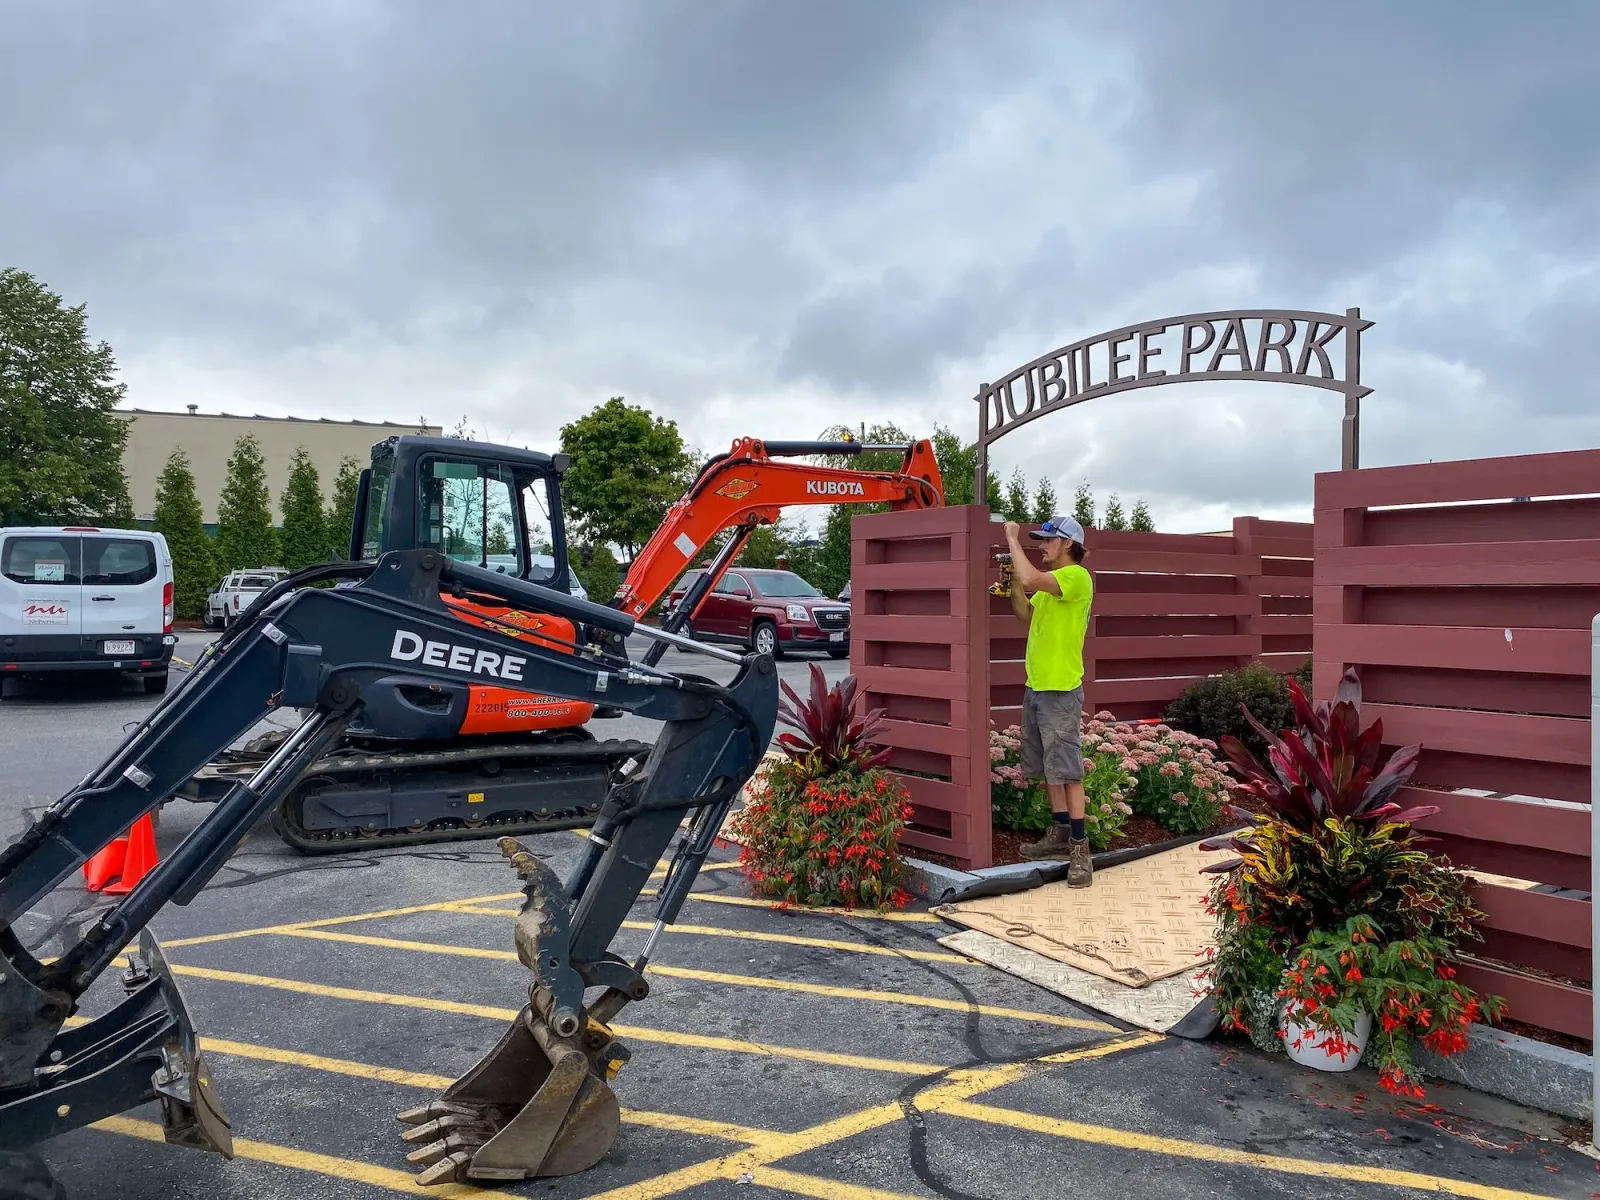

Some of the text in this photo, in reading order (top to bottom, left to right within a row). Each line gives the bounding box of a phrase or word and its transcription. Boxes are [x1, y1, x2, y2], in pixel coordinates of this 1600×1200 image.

[985, 316, 1344, 435] JUBILEE PARK
[806, 480, 865, 496] KUBOTA
[390, 629, 527, 681] DEERE
[475, 703, 510, 713] 222015
